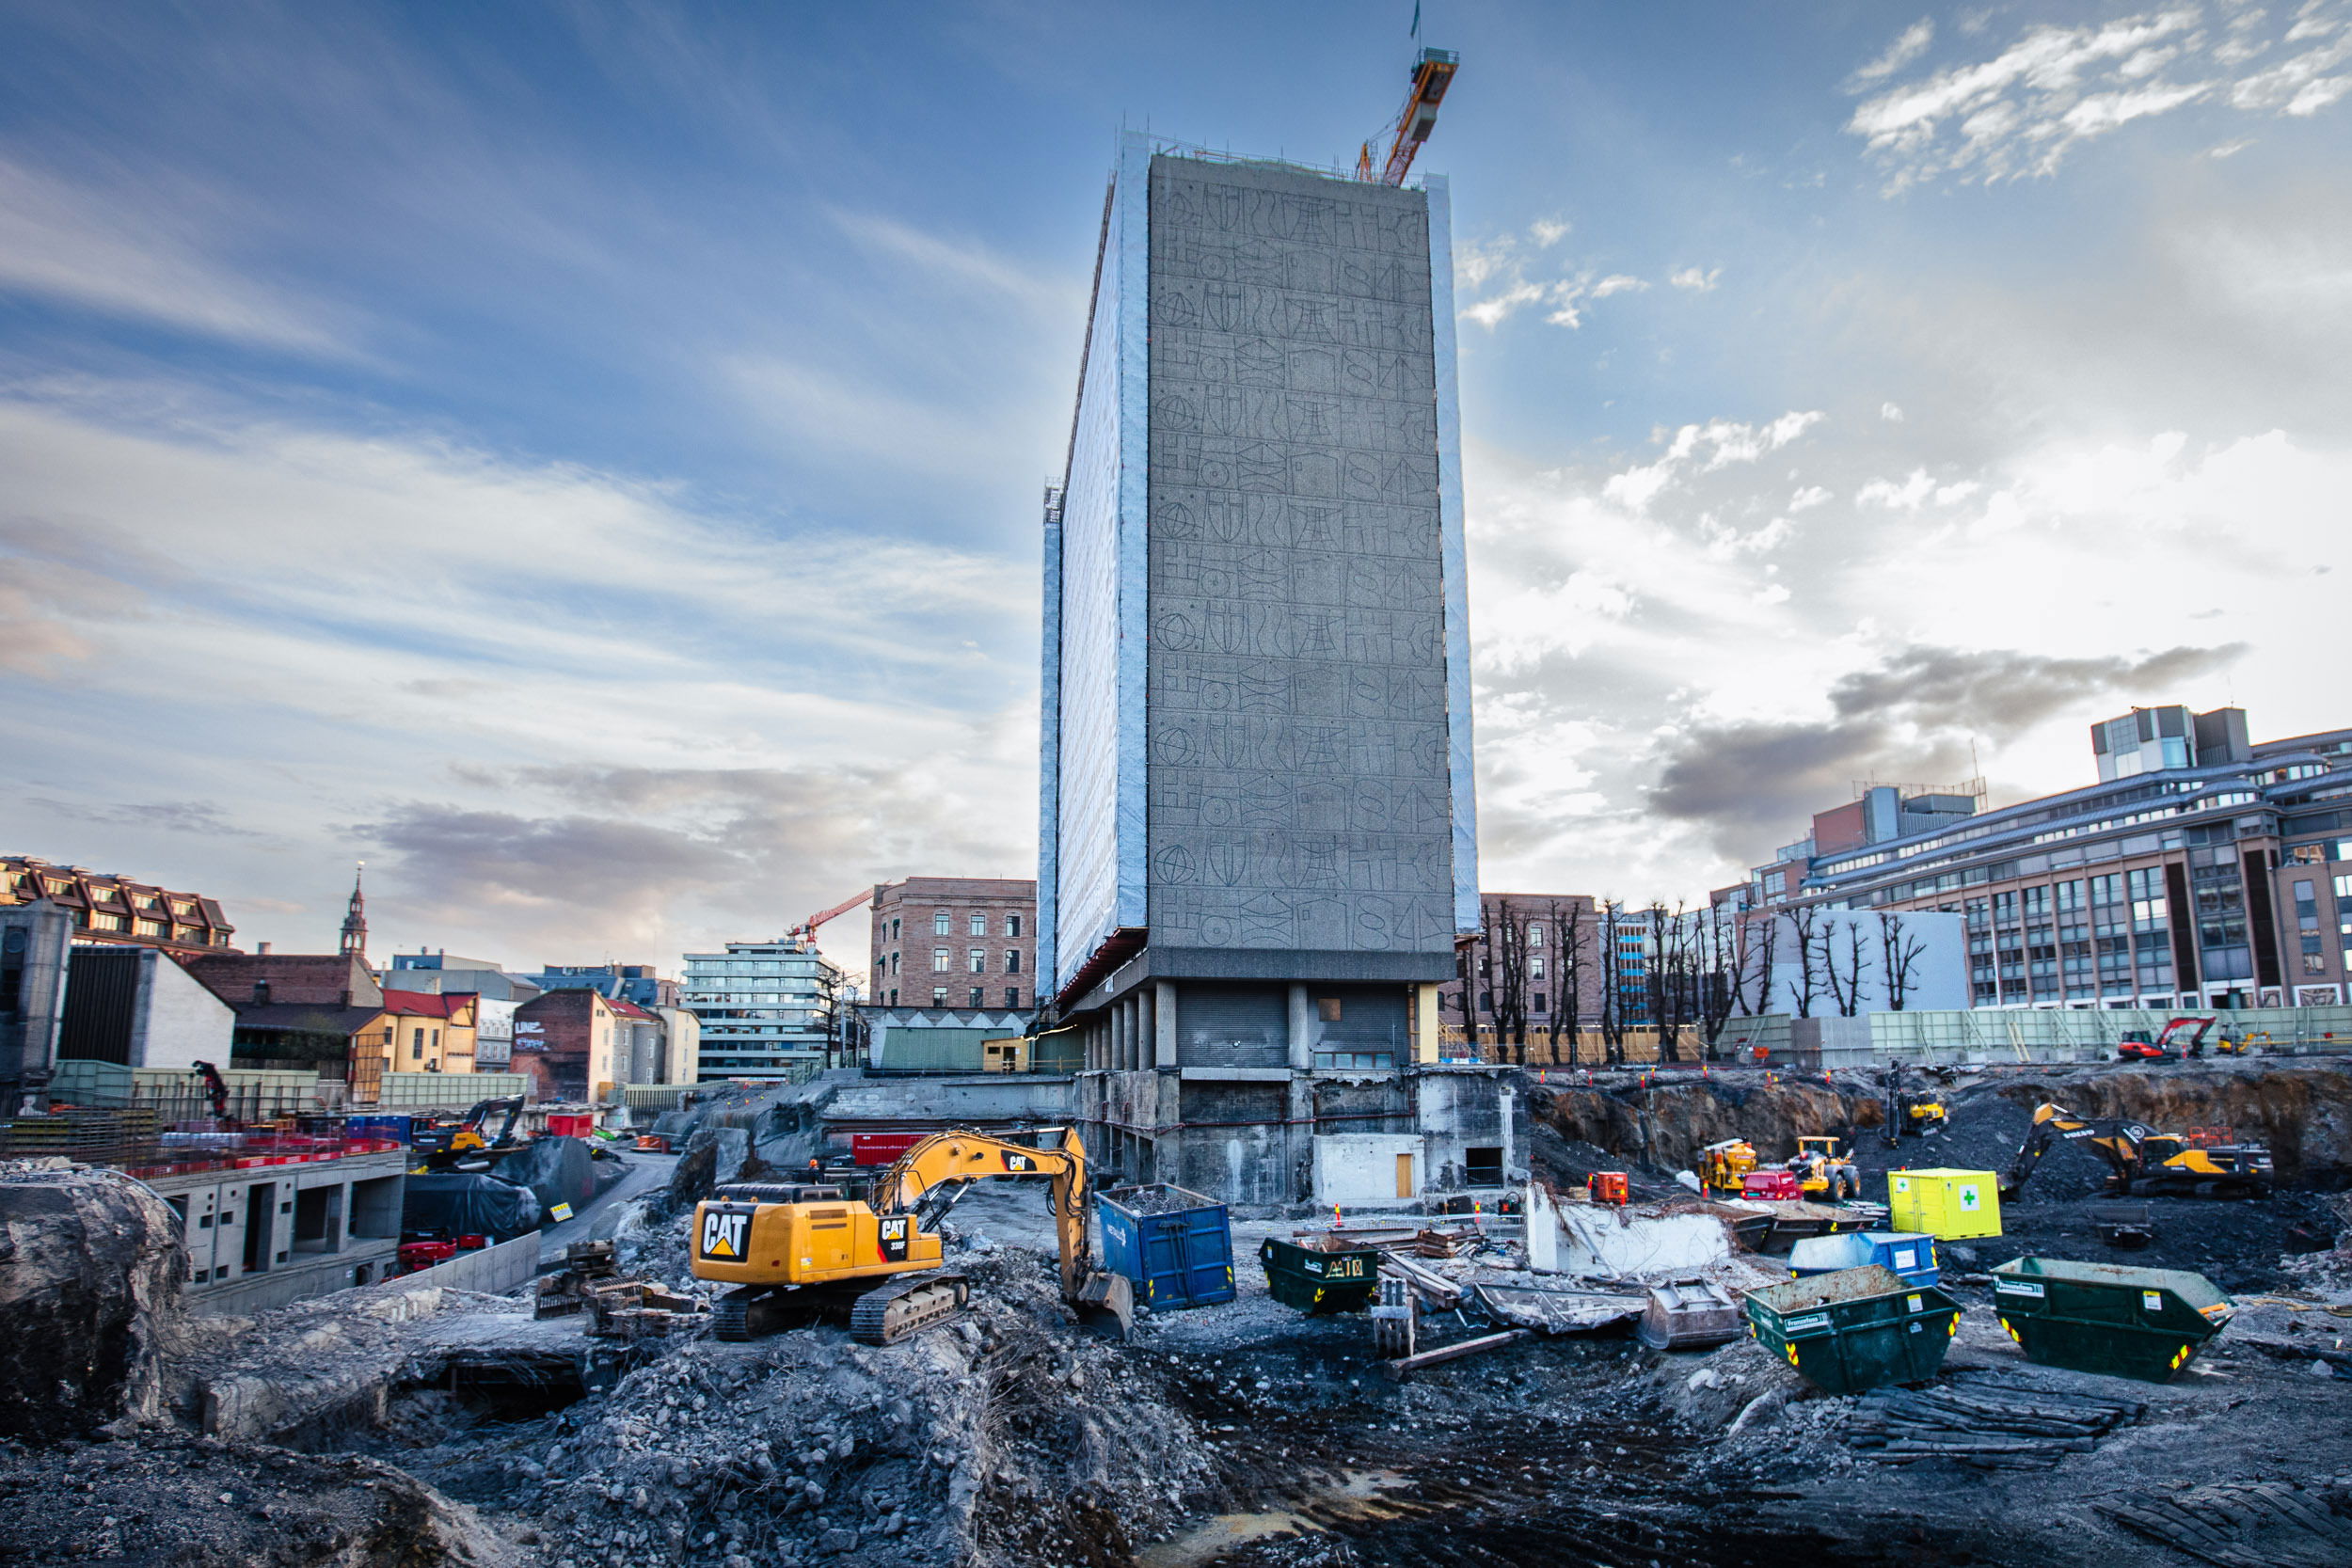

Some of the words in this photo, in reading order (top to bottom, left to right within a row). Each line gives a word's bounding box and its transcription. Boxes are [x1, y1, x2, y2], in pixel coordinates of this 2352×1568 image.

[2062, 1129, 2095, 1139] VOLVO
[1009, 1156, 1026, 1171] CAT
[703, 1212, 748, 1257] CAT
[882, 1219, 906, 1240] CAT
